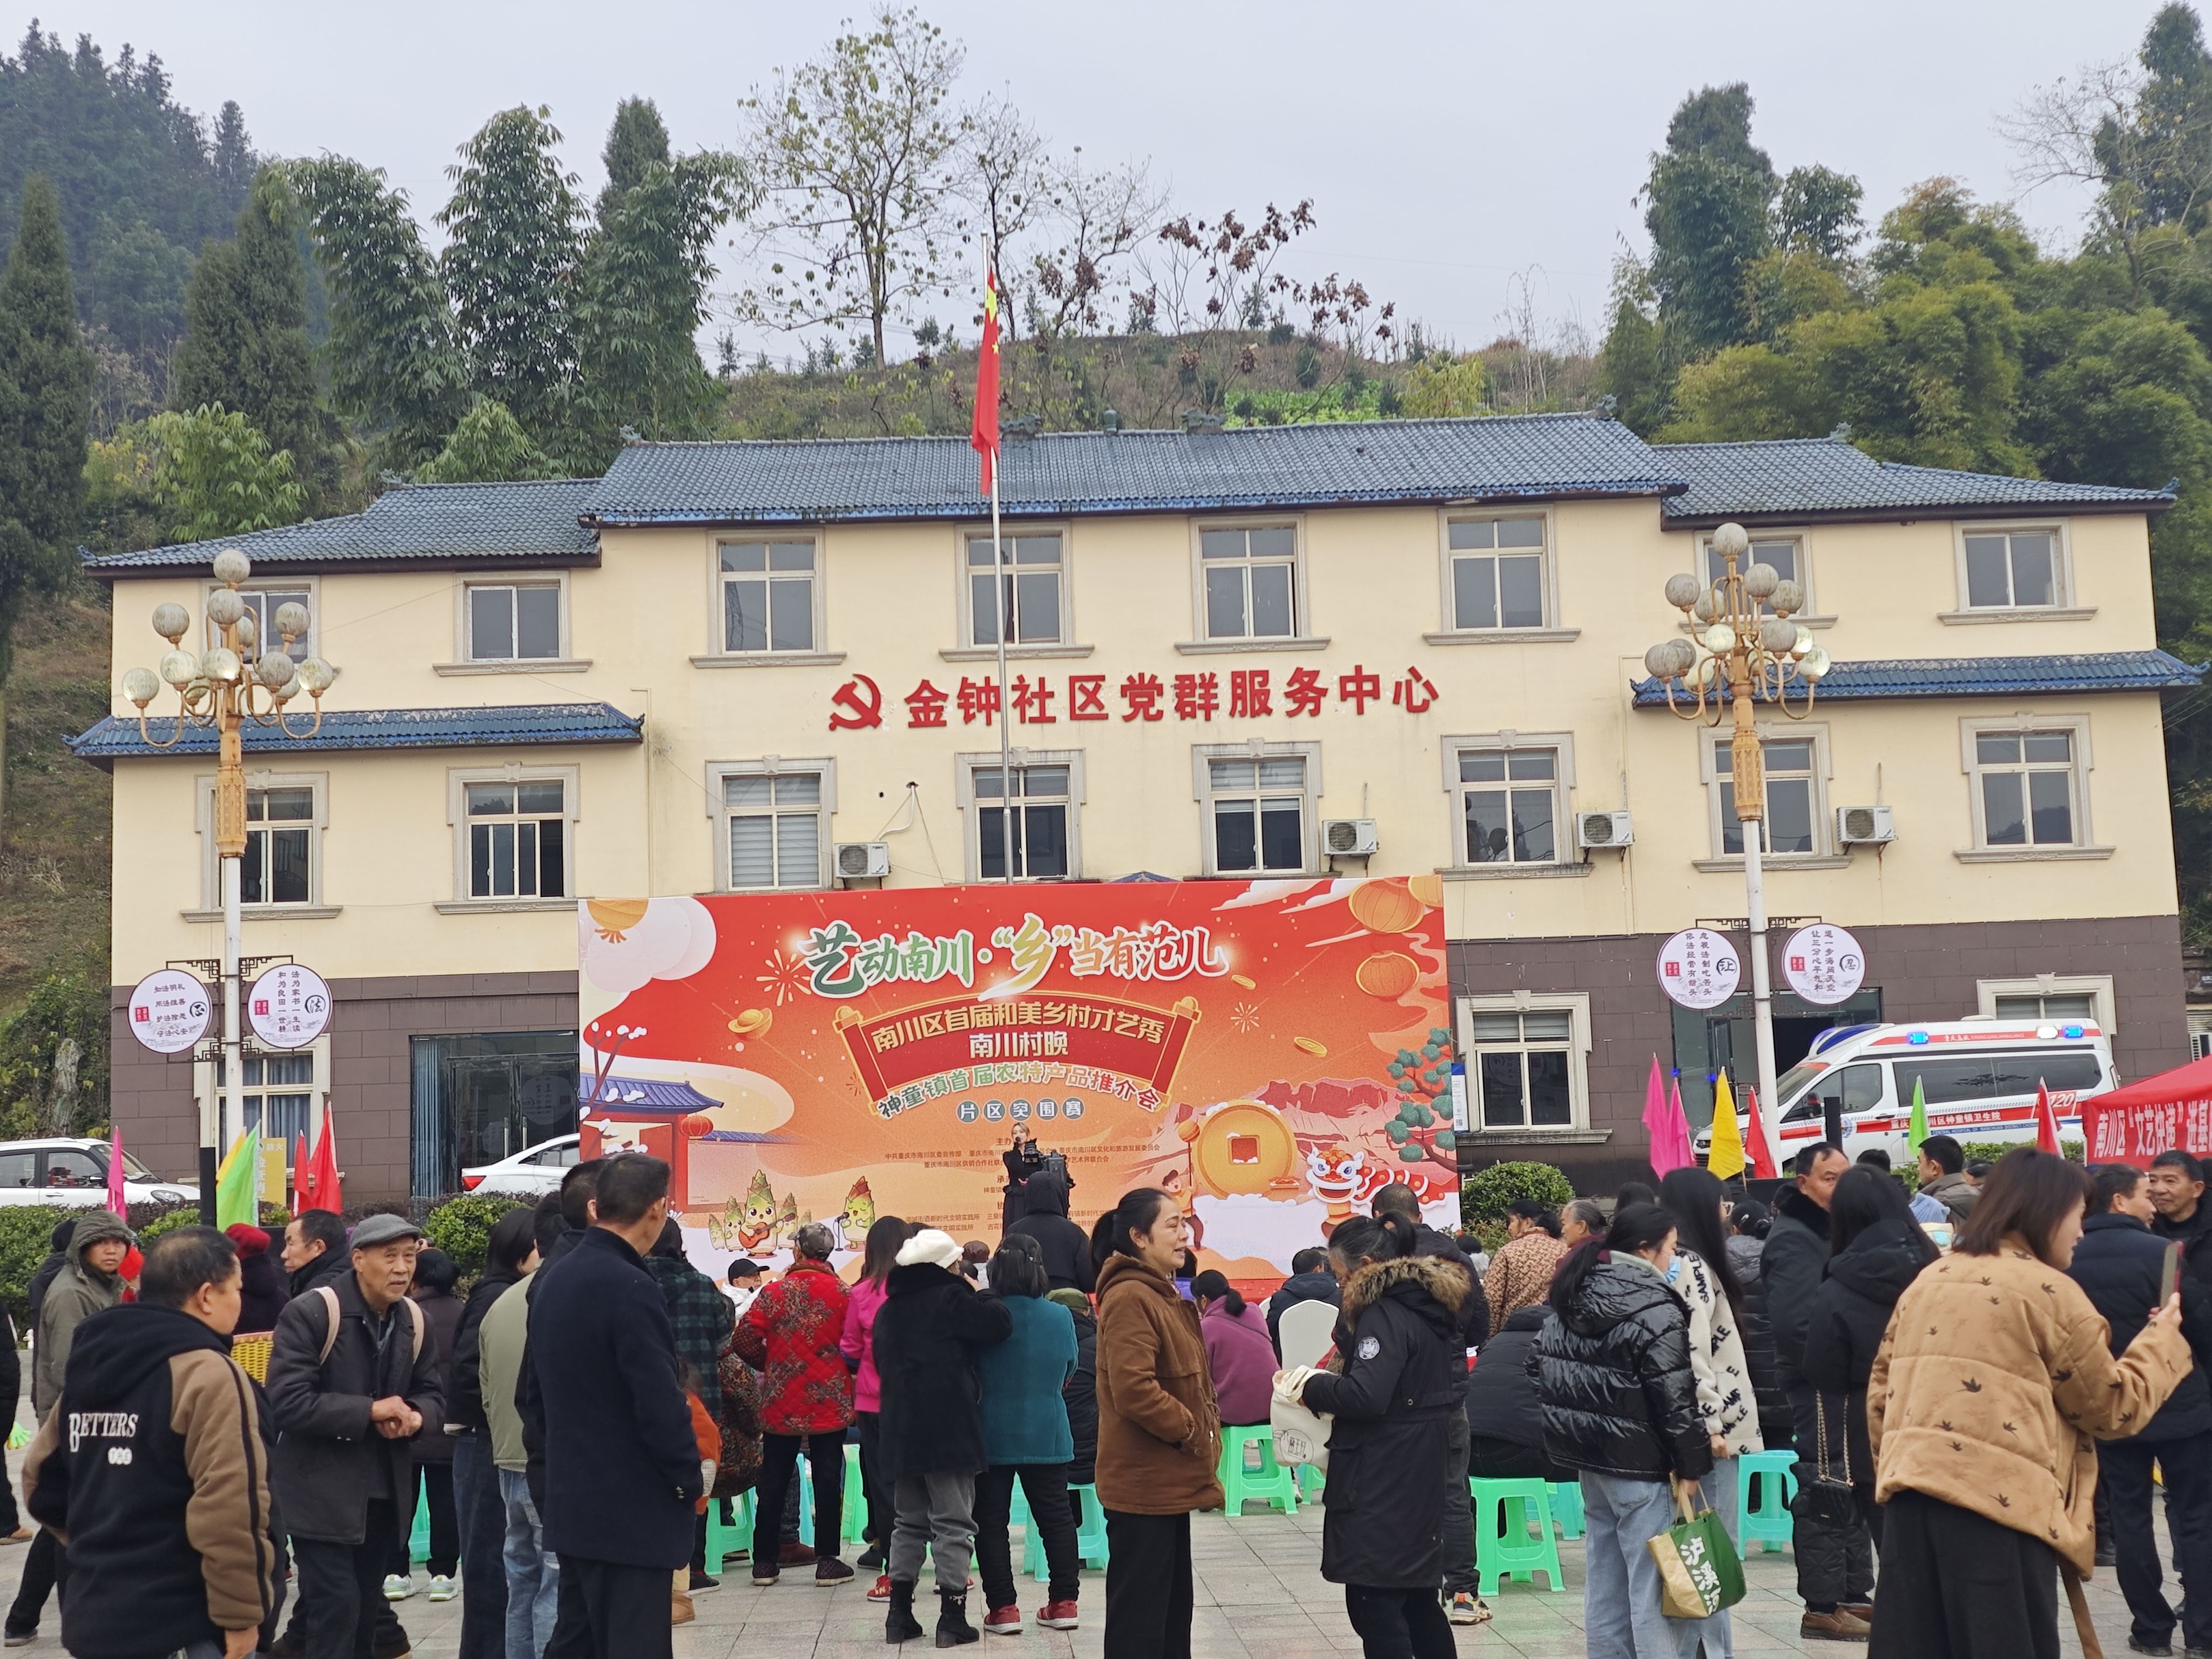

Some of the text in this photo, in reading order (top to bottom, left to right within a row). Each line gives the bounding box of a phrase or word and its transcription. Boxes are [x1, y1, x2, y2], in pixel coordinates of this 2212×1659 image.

[904, 664, 1439, 728] 金钟社区党群服务中心
[309, 997, 323, 1014] 法
[870, 1001, 1165, 1054] 南川区首届和美乡村才艺秀
[969, 1031, 1069, 1059] 南川村晚
[877, 1062, 1162, 1118] 神童镇首届农特产品推介会
[2049, 1093, 2075, 1108] 120
[959, 1100, 1084, 1121] 片区突围赛
[1891, 1111, 2001, 1129] 重庆川区神童镇卫生院
[996, 1137, 1011, 1146] 主办
[2094, 1100, 2212, 1158] 南川区“文艺快递”进基
[1689, 1254, 1709, 1304] SAMPLE
[68, 1412, 139, 1453] BETTERS
